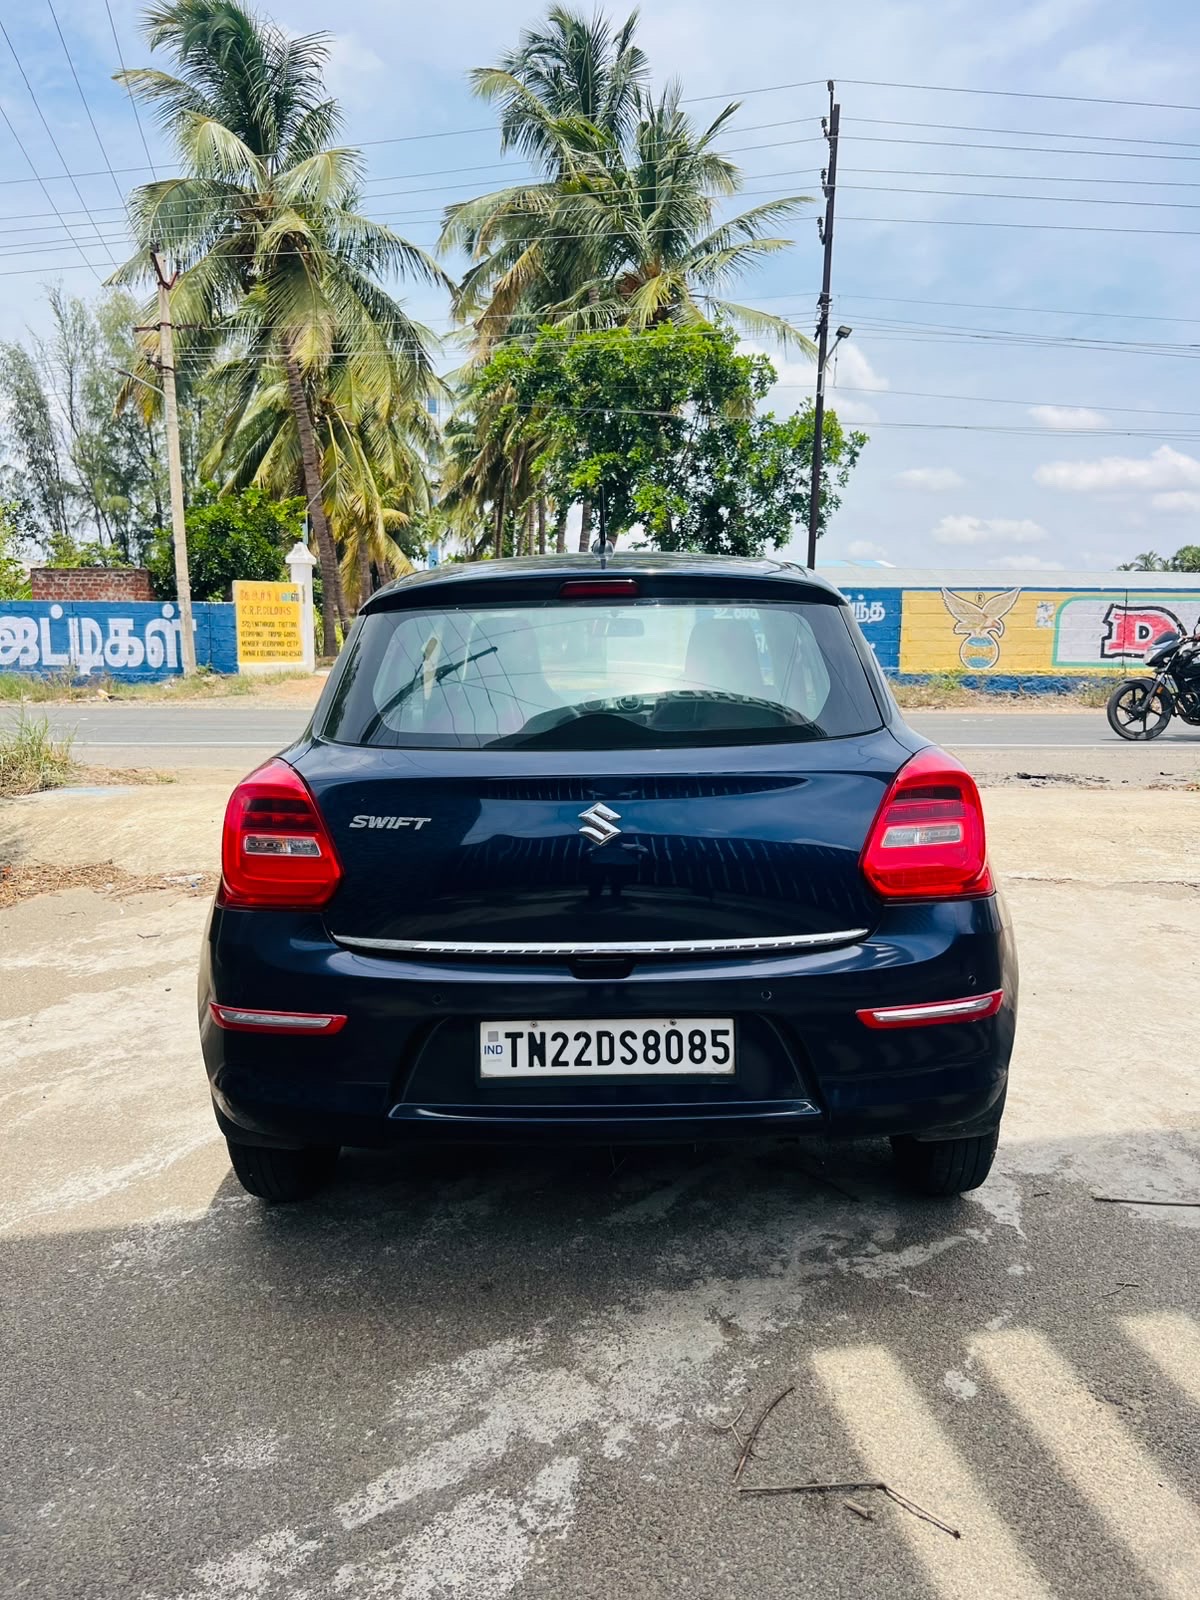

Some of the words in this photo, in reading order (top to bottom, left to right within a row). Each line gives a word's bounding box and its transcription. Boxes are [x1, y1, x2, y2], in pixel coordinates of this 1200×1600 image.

[349, 814, 432, 831] SWIFT
[484, 1044, 503, 1055] IND
[504, 1029, 730, 1068] TN22DS8085
